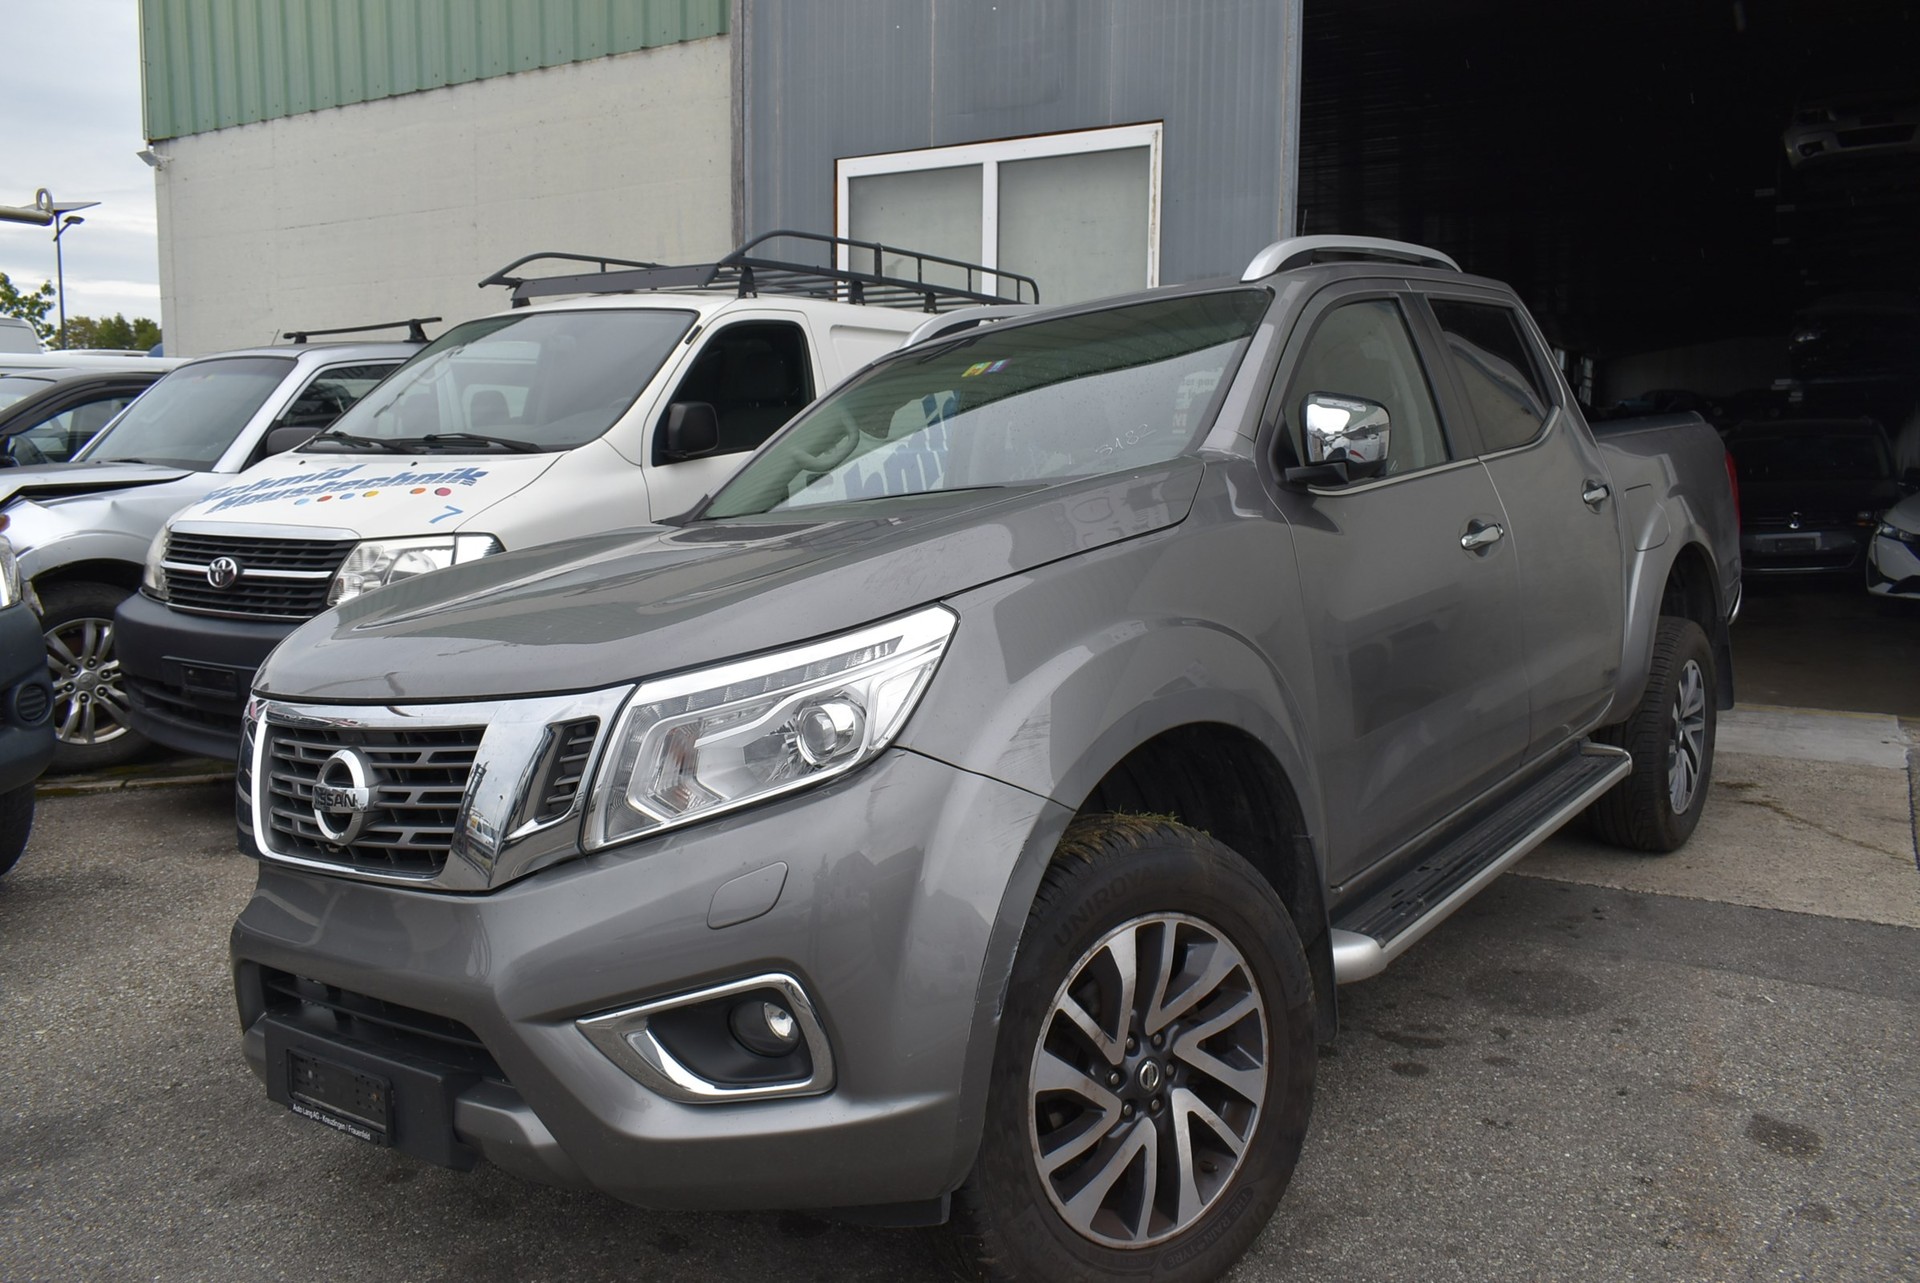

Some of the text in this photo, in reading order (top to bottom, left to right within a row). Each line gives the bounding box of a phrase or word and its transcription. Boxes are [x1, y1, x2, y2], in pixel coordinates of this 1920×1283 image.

[429, 505, 464, 524] 7
[314, 786, 354, 808] SSAN
[1203, 1218, 1231, 1243] RAIN
[1168, 1246, 1199, 1266] TYRE
